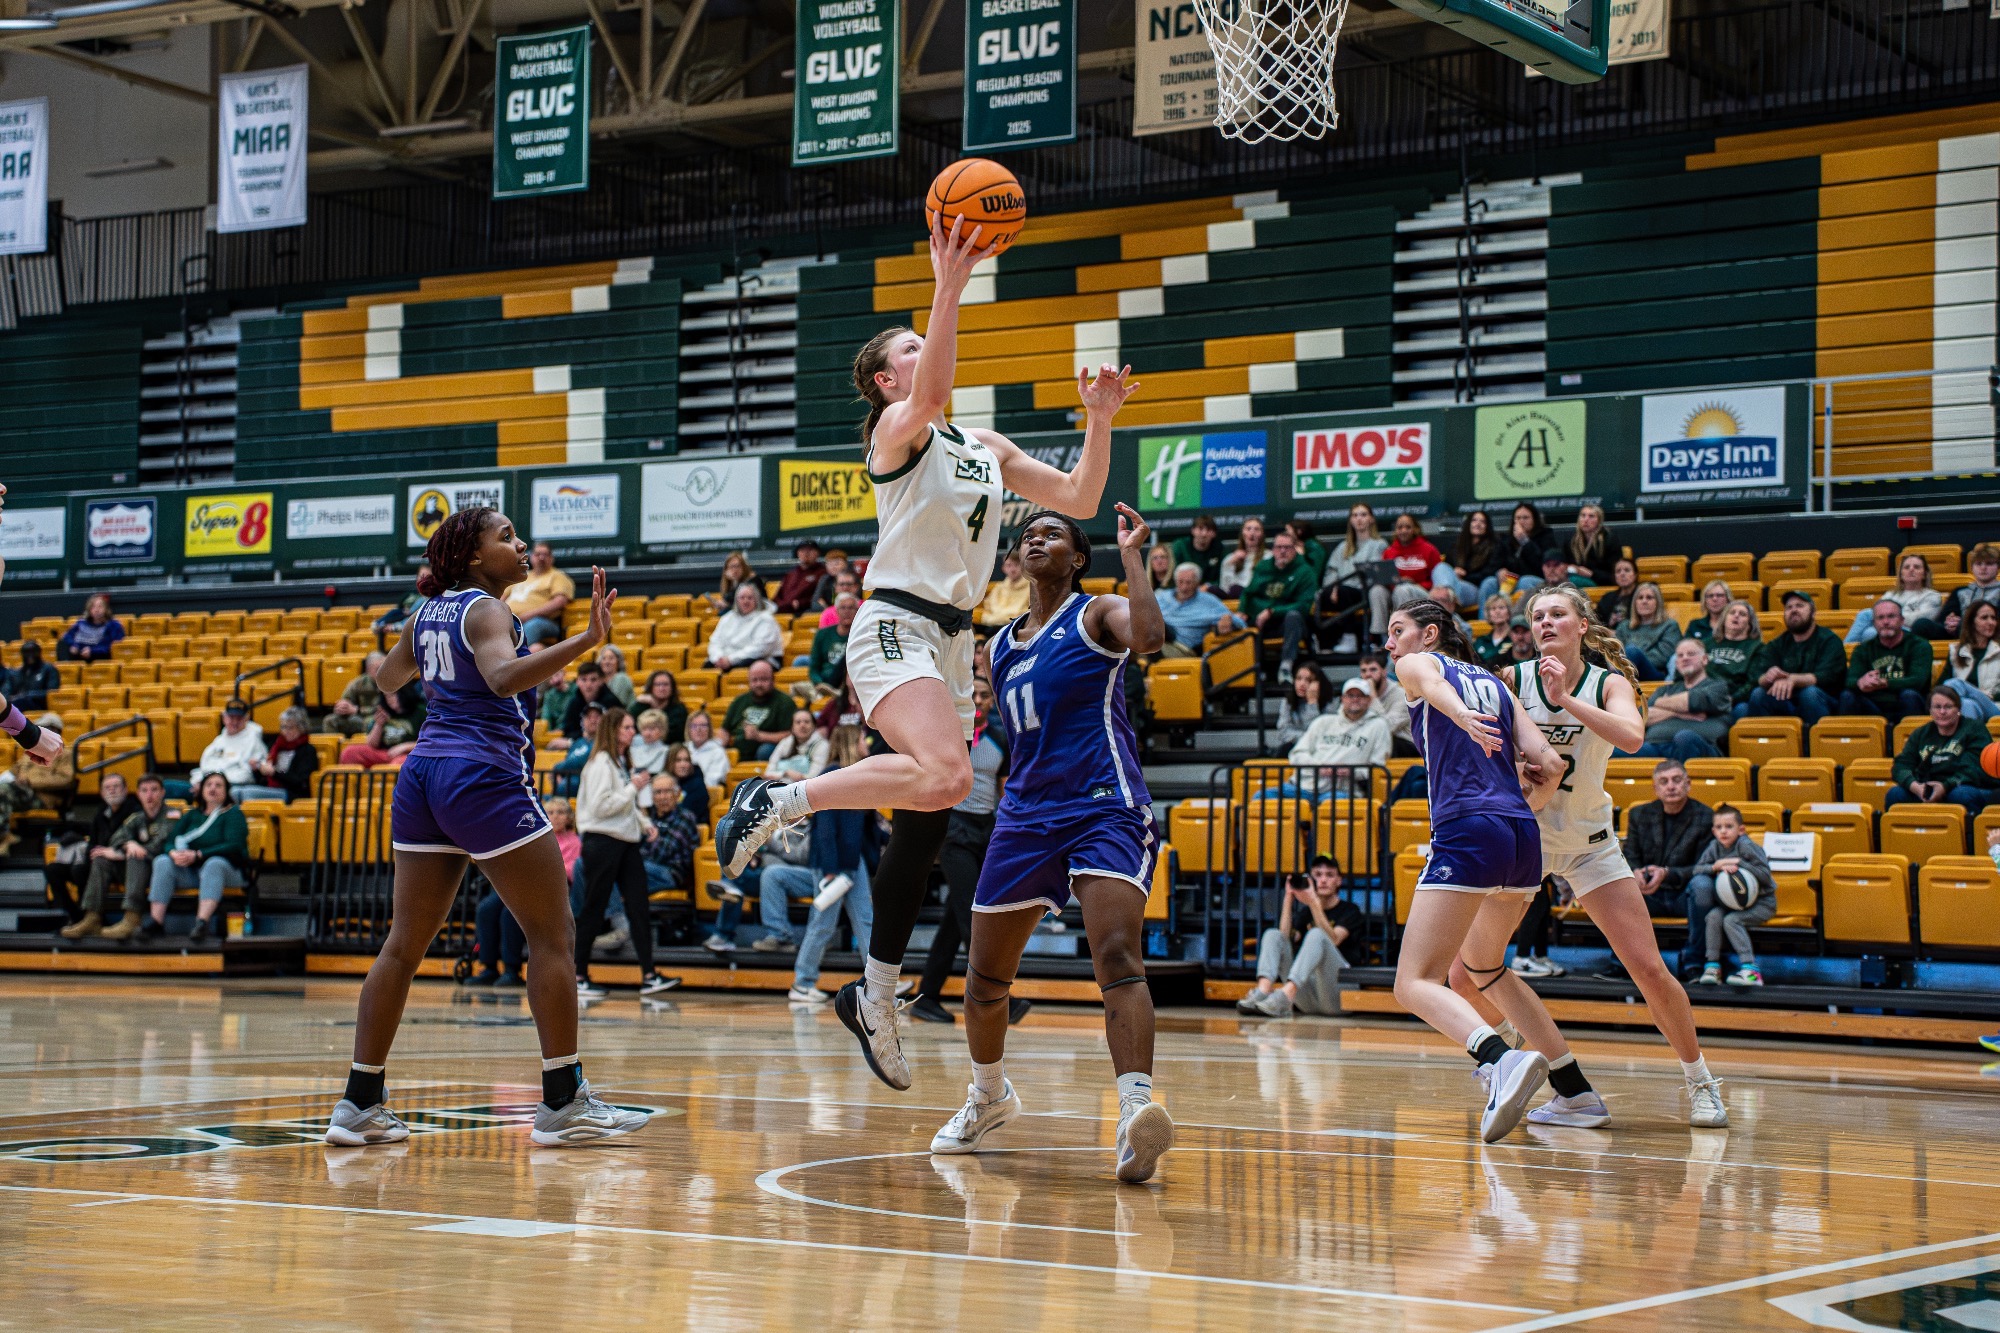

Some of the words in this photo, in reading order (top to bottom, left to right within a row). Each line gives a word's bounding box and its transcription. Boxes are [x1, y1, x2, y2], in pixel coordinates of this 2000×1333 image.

[819, 0, 876, 20] WOMEN'S
[813, 16, 883, 40] VOLLEYBALL
[515, 39, 569, 62] WOMEN'S
[978, 20, 1060, 65] GLVC
[510, 56, 574, 80] BASKETBALL
[806, 43, 883, 85] GLVC
[1169, 50, 1216, 67] NATIONA
[976, 74, 1022, 93] REGULAR
[1022, 69, 1063, 88] SEASON
[1160, 68, 1217, 87] TOURNAME
[506, 82, 576, 122] GLVC
[989, 88, 1050, 109] CHAMPIONS
[816, 105, 872, 126] CHAMPIONS
[233, 122, 291, 156] MIAA
[515, 142, 566, 161] CHAMPIONS
[980, 191, 1026, 213] Wilso
[1296, 427, 1424, 471] IMO'S
[1652, 446, 1720, 469] Days
[1723, 443, 1772, 464] Inn
[790, 468, 870, 498] DICKEY'S
[1205, 462, 1263, 484] Express
[1299, 469, 1419, 492] PIZZA
[1662, 471, 1682, 482] BY
[1686, 466, 1764, 481] WYNDHAM
[354, 506, 390, 522] Health
[539, 495, 614, 513] BAYMONT
[795, 499, 843, 513] BARBECUE
[189, 503, 239, 538] Super
[236, 500, 269, 549] 8
[968, 494, 988, 542] 4
[419, 630, 455, 682] 30
[1006, 681, 1041, 735] 11
